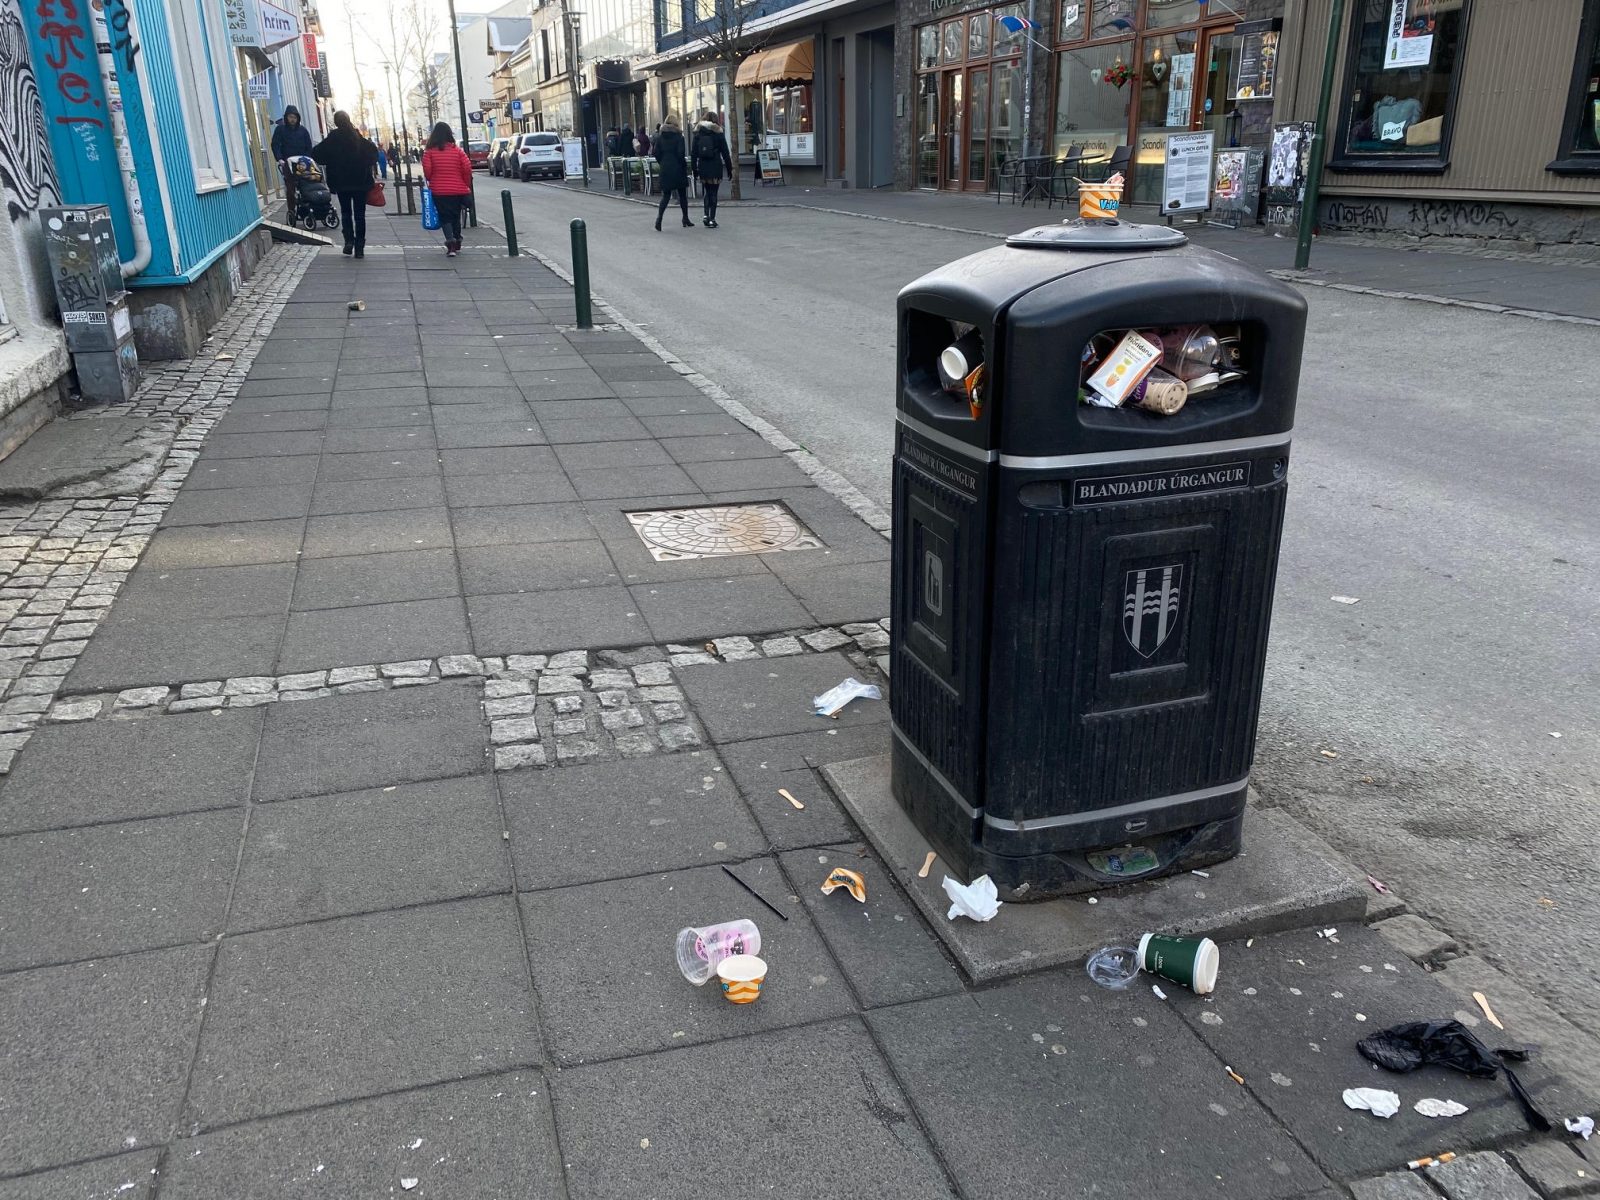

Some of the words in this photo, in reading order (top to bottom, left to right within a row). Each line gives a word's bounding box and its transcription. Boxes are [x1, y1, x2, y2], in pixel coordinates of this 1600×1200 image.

[1383, 126, 1401, 136] BRAVO
[1080, 478, 1167, 499] BLANDAÐUR
[1170, 468, 1244, 488] ÚRGANGUR
